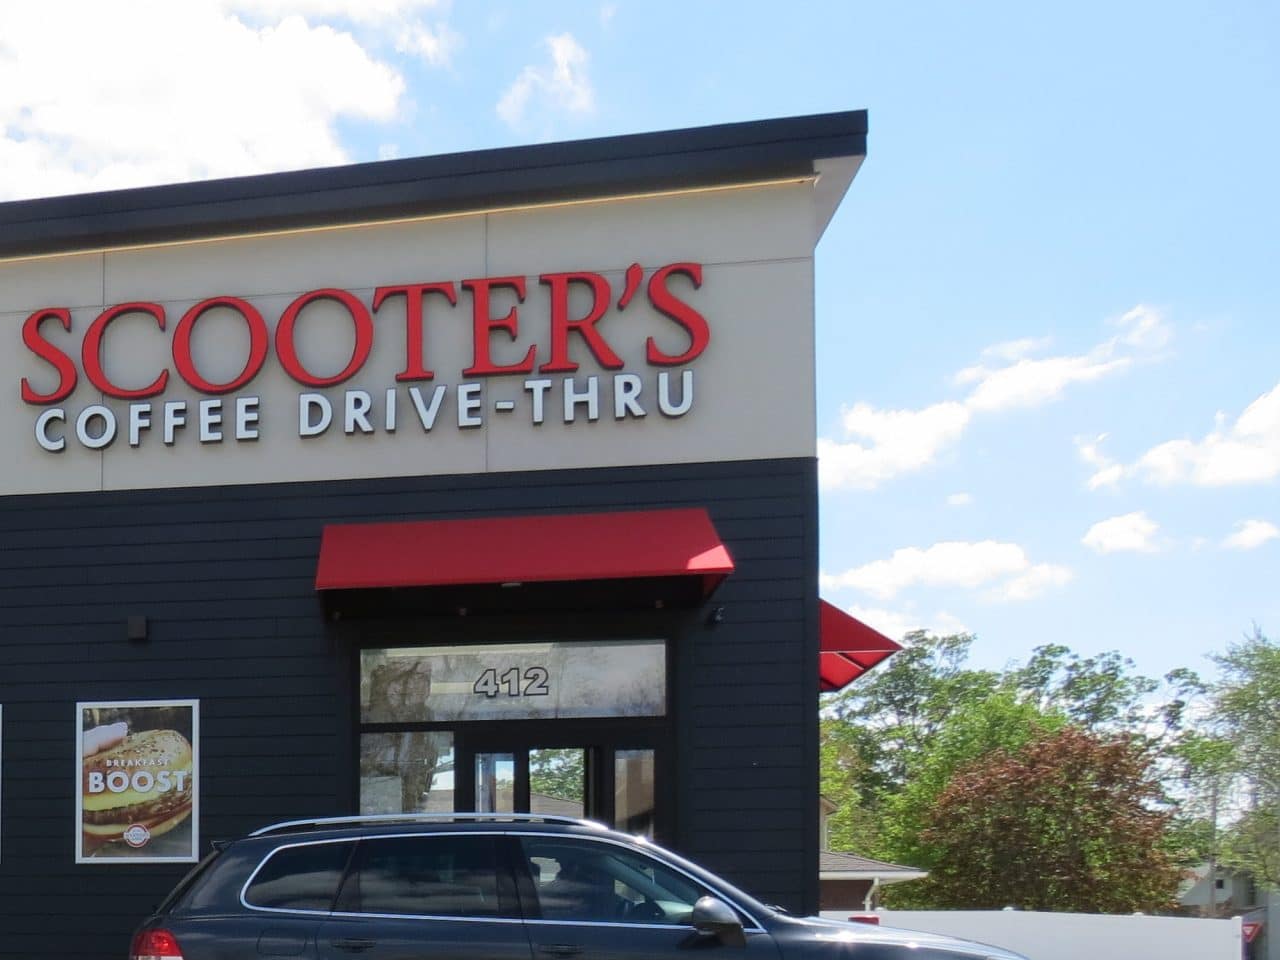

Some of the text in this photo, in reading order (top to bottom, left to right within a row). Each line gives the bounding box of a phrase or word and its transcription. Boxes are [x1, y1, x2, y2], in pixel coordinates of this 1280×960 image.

[21, 262, 711, 404] SCOOTER'S
[35, 369, 695, 452] COFFEE DRIVE-THRU
[474, 667, 549, 696] 412
[106, 759, 168, 767] BREAKFAST
[88, 770, 188, 793] BOOST
